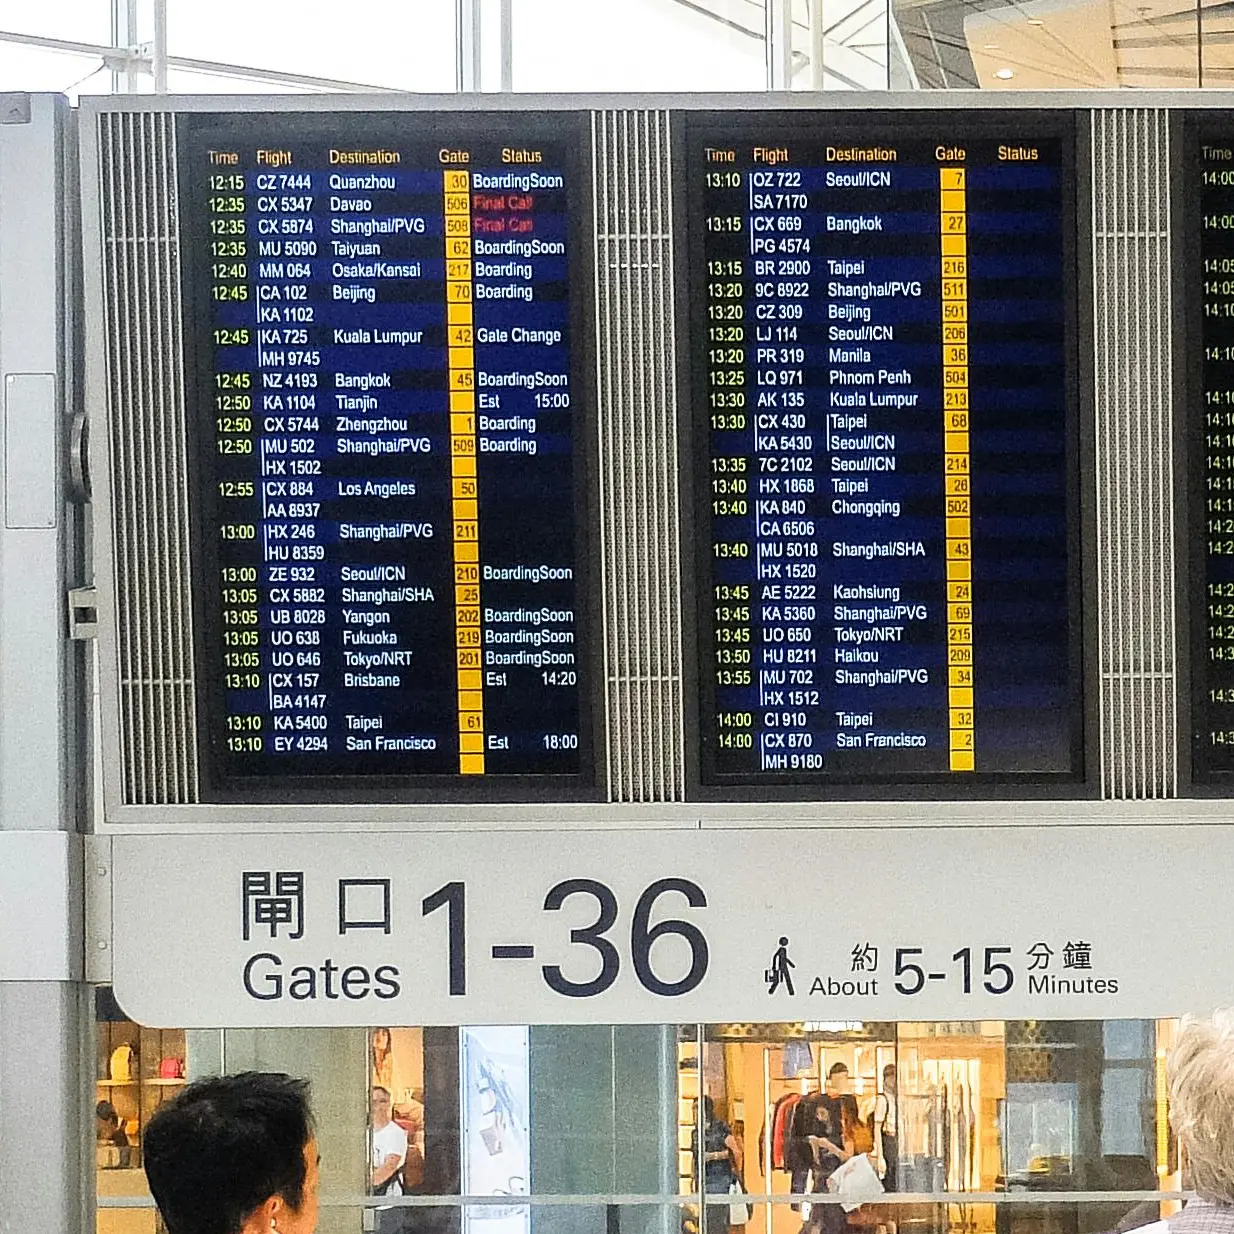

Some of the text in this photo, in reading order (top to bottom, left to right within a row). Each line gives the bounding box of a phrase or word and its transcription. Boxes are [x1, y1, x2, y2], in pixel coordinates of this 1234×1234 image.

[207, 148, 542, 168] Time Flight Destination Gate Status
[705, 145, 1039, 165] Time Flight Destination Gate Status
[210, 175, 244, 190] 12:15
[256, 174, 277, 190] CZ
[279, 174, 311, 190] 7444
[329, 173, 396, 190] Quanzhou
[472, 172, 563, 192] BoardingSoon
[706, 216, 742, 232] 13:15
[754, 216, 775, 232] CX
[777, 216, 802, 231] 669
[826, 215, 883, 234] Bangkok
[211, 241, 247, 257] 12:35
[258, 240, 281, 256] MU
[284, 240, 317, 256] 5090
[330, 240, 381, 259] Taiyuan
[474, 239, 565, 258] BoardingSoon
[212, 261, 533, 280] 12:40 MM 064 Osaka/Kansai Boarding
[755, 259, 865, 279] BR 2900 Taipei
[213, 327, 562, 347] 12:45 KA 725 Kuala Lumpur Gate Change
[709, 348, 744, 364] 13:20
[757, 348, 777, 364] PR
[780, 348, 805, 363] 319
[829, 347, 871, 363] Manila
[829, 369, 912, 385] Phnom Penh
[336, 416, 408, 435] Zhengzhou
[219, 480, 416, 499] 12:55 CX 884 Los Angeles
[831, 499, 901, 518] Chongqing
[339, 523, 433, 542] Shanghai/PVG
[715, 584, 900, 602] 13:45 AE 5222 Kaohsiung
[223, 607, 574, 627] 13:05 Yangon BoardingSoon
[834, 626, 904, 645] Tokyo/NRT
[344, 671, 577, 687] Brisbane 14:20
[717, 711, 873, 730] 14:00 CI 910 Taipei
[346, 734, 578, 751] San Francisco 18:00
[243, 872, 390, 940] 閘口
[244, 878, 708, 1000] Gates 1-36
[852, 943, 877, 971] 約
[1027, 941, 1092, 970] 分鐘
[810, 948, 1118, 995] About 5-15 Minutes
